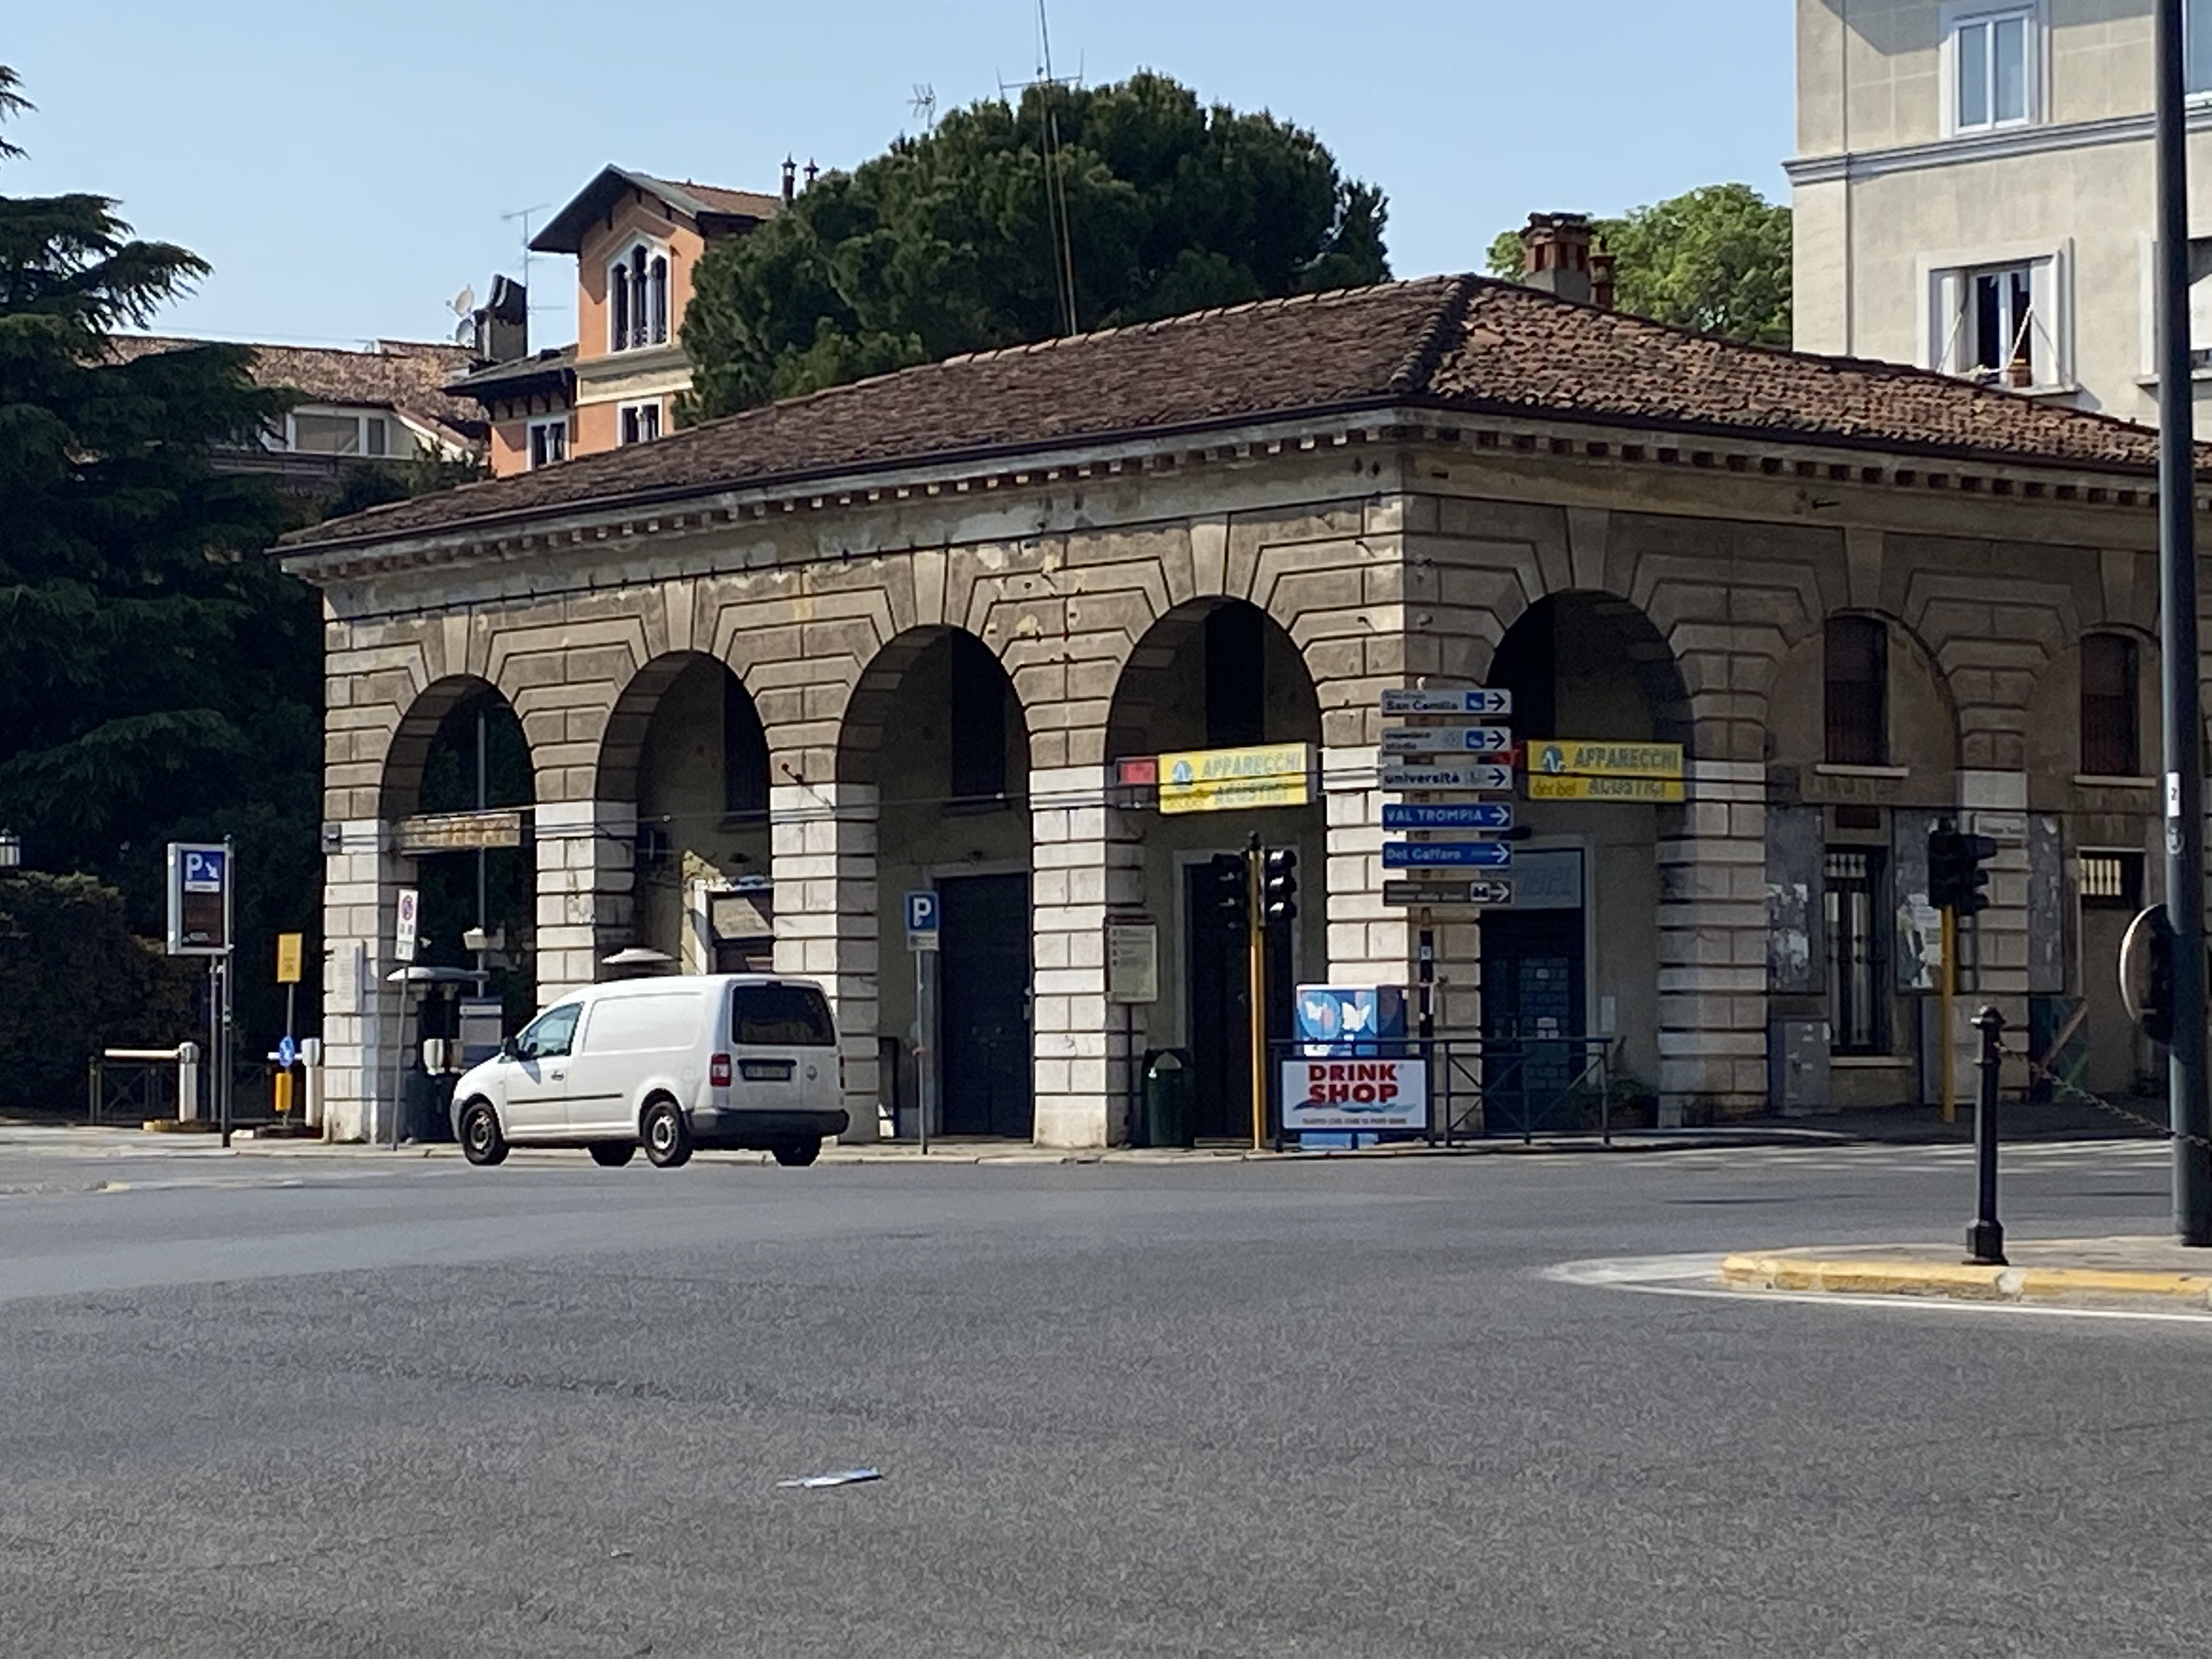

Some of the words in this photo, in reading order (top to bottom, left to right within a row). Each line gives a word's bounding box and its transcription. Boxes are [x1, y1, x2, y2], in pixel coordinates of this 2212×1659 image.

[1201, 752, 1302, 778] APPARECCHI
[1575, 747, 1678, 771] APPARECCHI
[1386, 809, 1413, 822] VAL
[1417, 809, 1483, 821] TROMPIA
[187, 853, 202, 881] P
[913, 896, 932, 927] P
[1308, 1063, 1397, 1081] DRINK
[1308, 1083, 1398, 1103] SHOP
